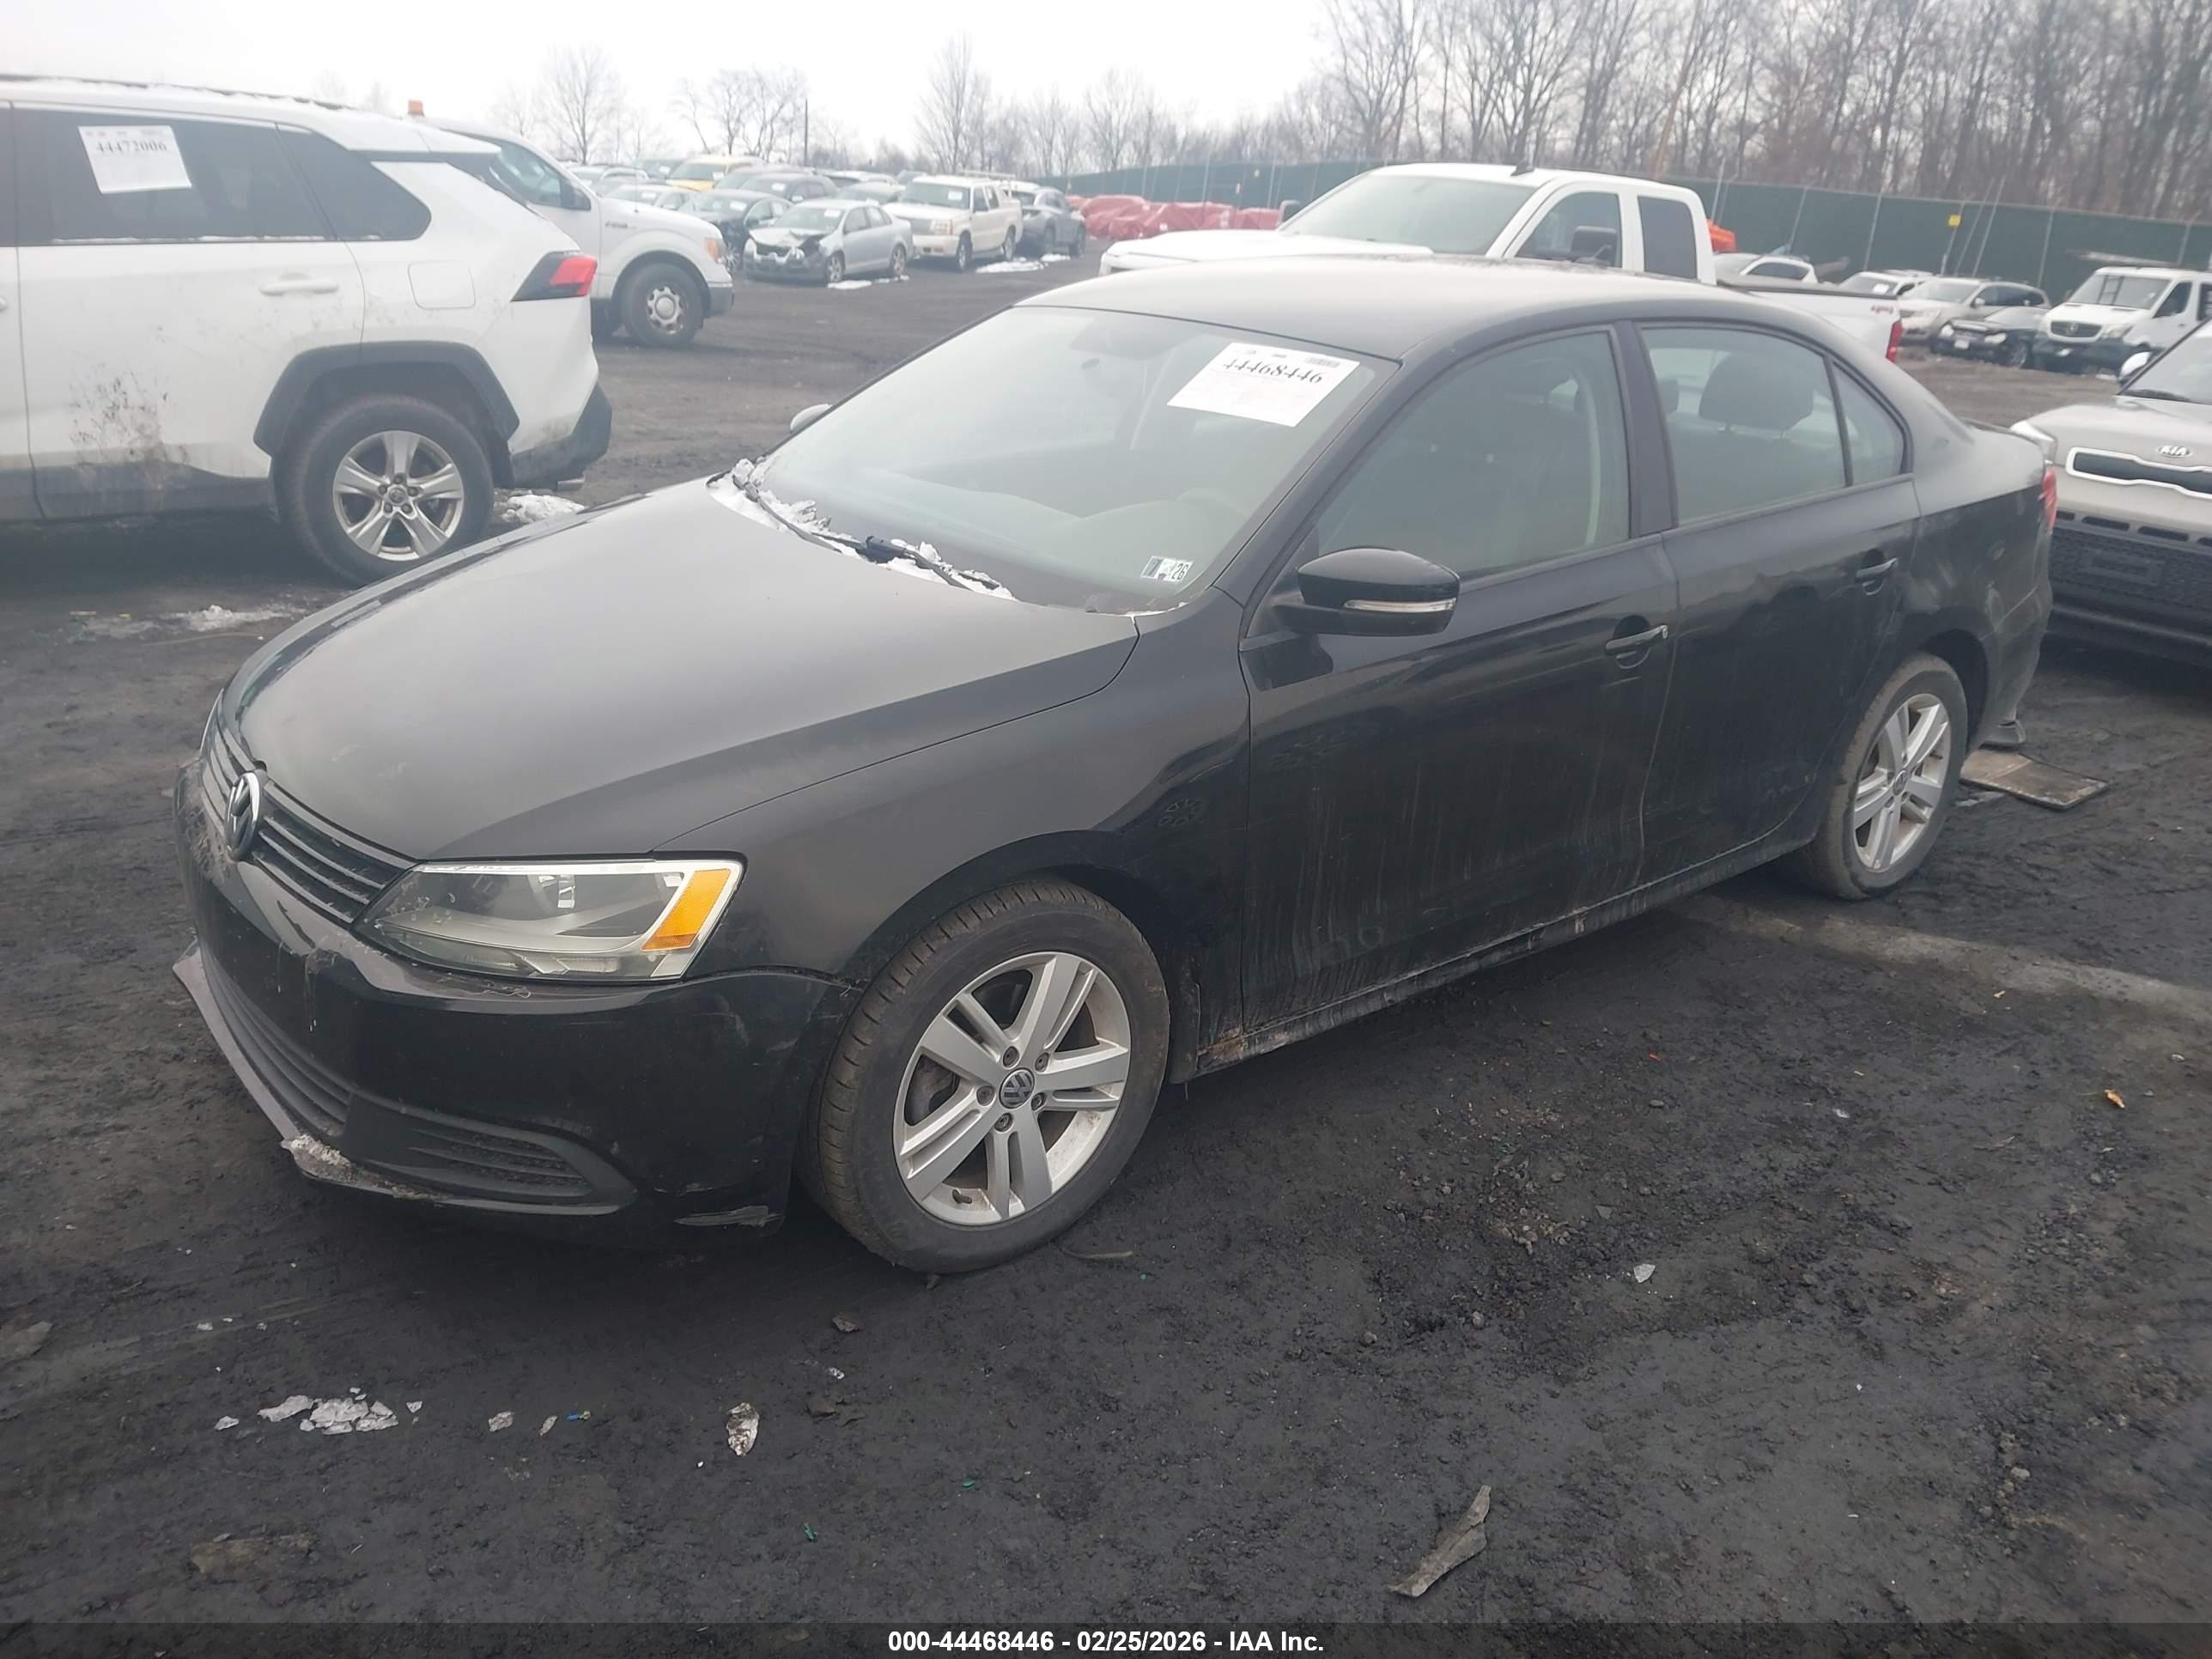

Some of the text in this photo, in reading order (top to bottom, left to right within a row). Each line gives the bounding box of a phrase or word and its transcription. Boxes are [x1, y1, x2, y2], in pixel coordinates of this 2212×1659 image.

[1224, 359, 1324, 384] 44468446
[2159, 444, 2187, 455] KIA
[1171, 563, 1189, 580] 26
[1000, 1069, 1033, 1109] VW
